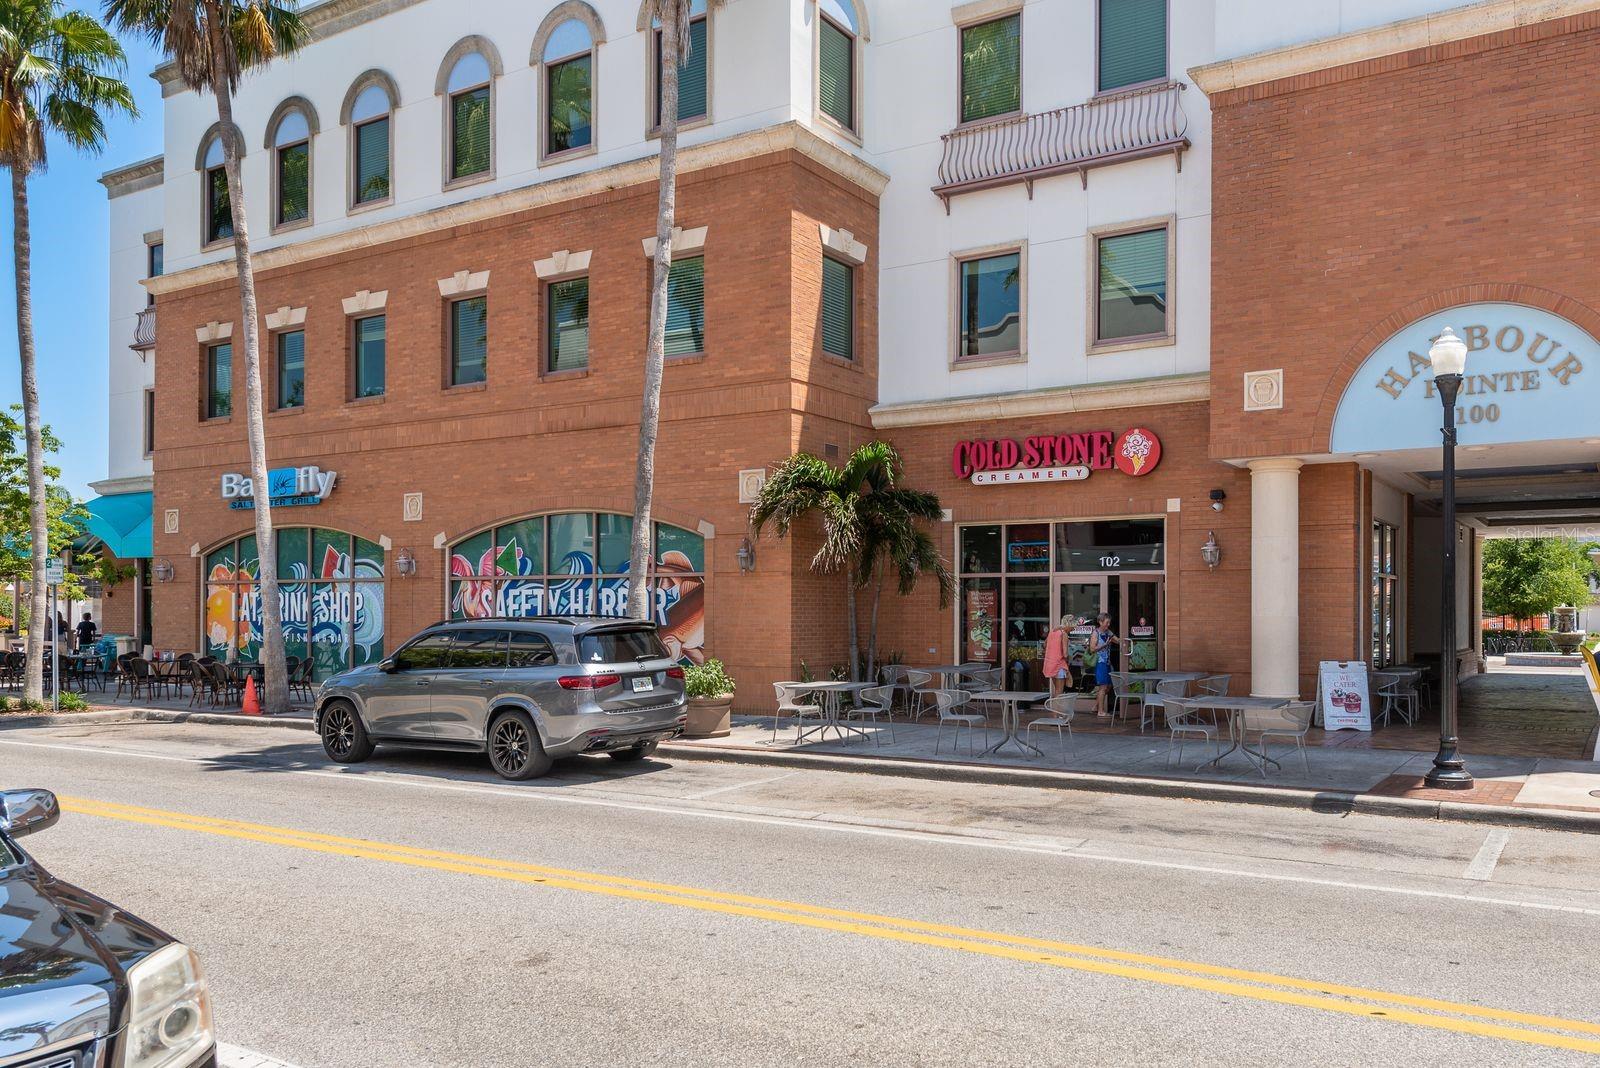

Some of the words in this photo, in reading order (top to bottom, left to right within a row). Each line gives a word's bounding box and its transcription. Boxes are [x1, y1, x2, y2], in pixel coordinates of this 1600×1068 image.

[1376, 324, 1583, 400] HABOUR
[1424, 369, 1541, 399] PINTE
[1456, 403, 1501, 425] 100
[952, 438, 1020, 480] COLD
[1022, 431, 1115, 471] STONE
[977, 469, 1084, 482] CREAMERY
[231, 499, 286, 509] SALTTER
[292, 496, 318, 505] GRILL
[46, 559, 51, 567] 2
[1099, 556, 1120, 567] 102
[319, 591, 364, 623] SHOP
